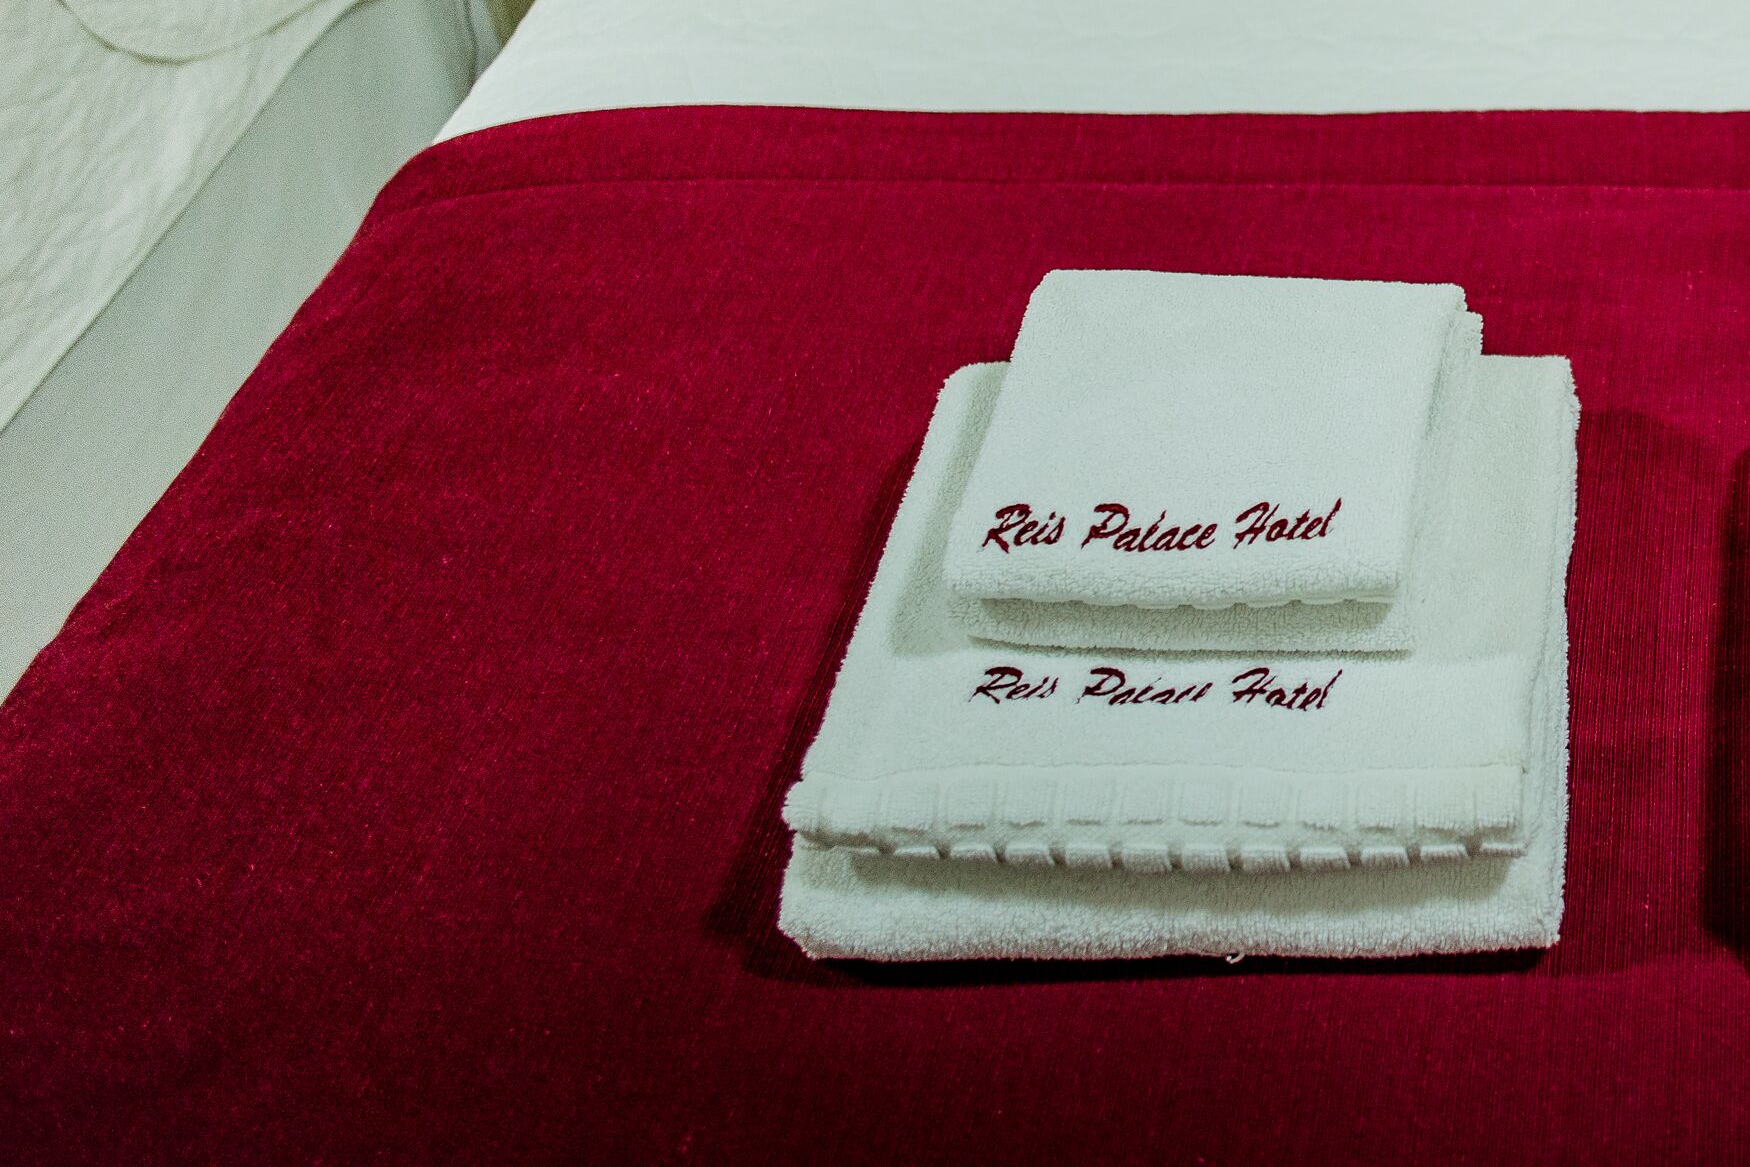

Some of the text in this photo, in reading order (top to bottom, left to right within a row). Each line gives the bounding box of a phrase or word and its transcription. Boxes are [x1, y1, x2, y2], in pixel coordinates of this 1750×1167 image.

[982, 498, 1341, 554] Reis Palace Hotel
[969, 666, 1058, 704] Reis
[1232, 667, 1342, 711] Hotel
